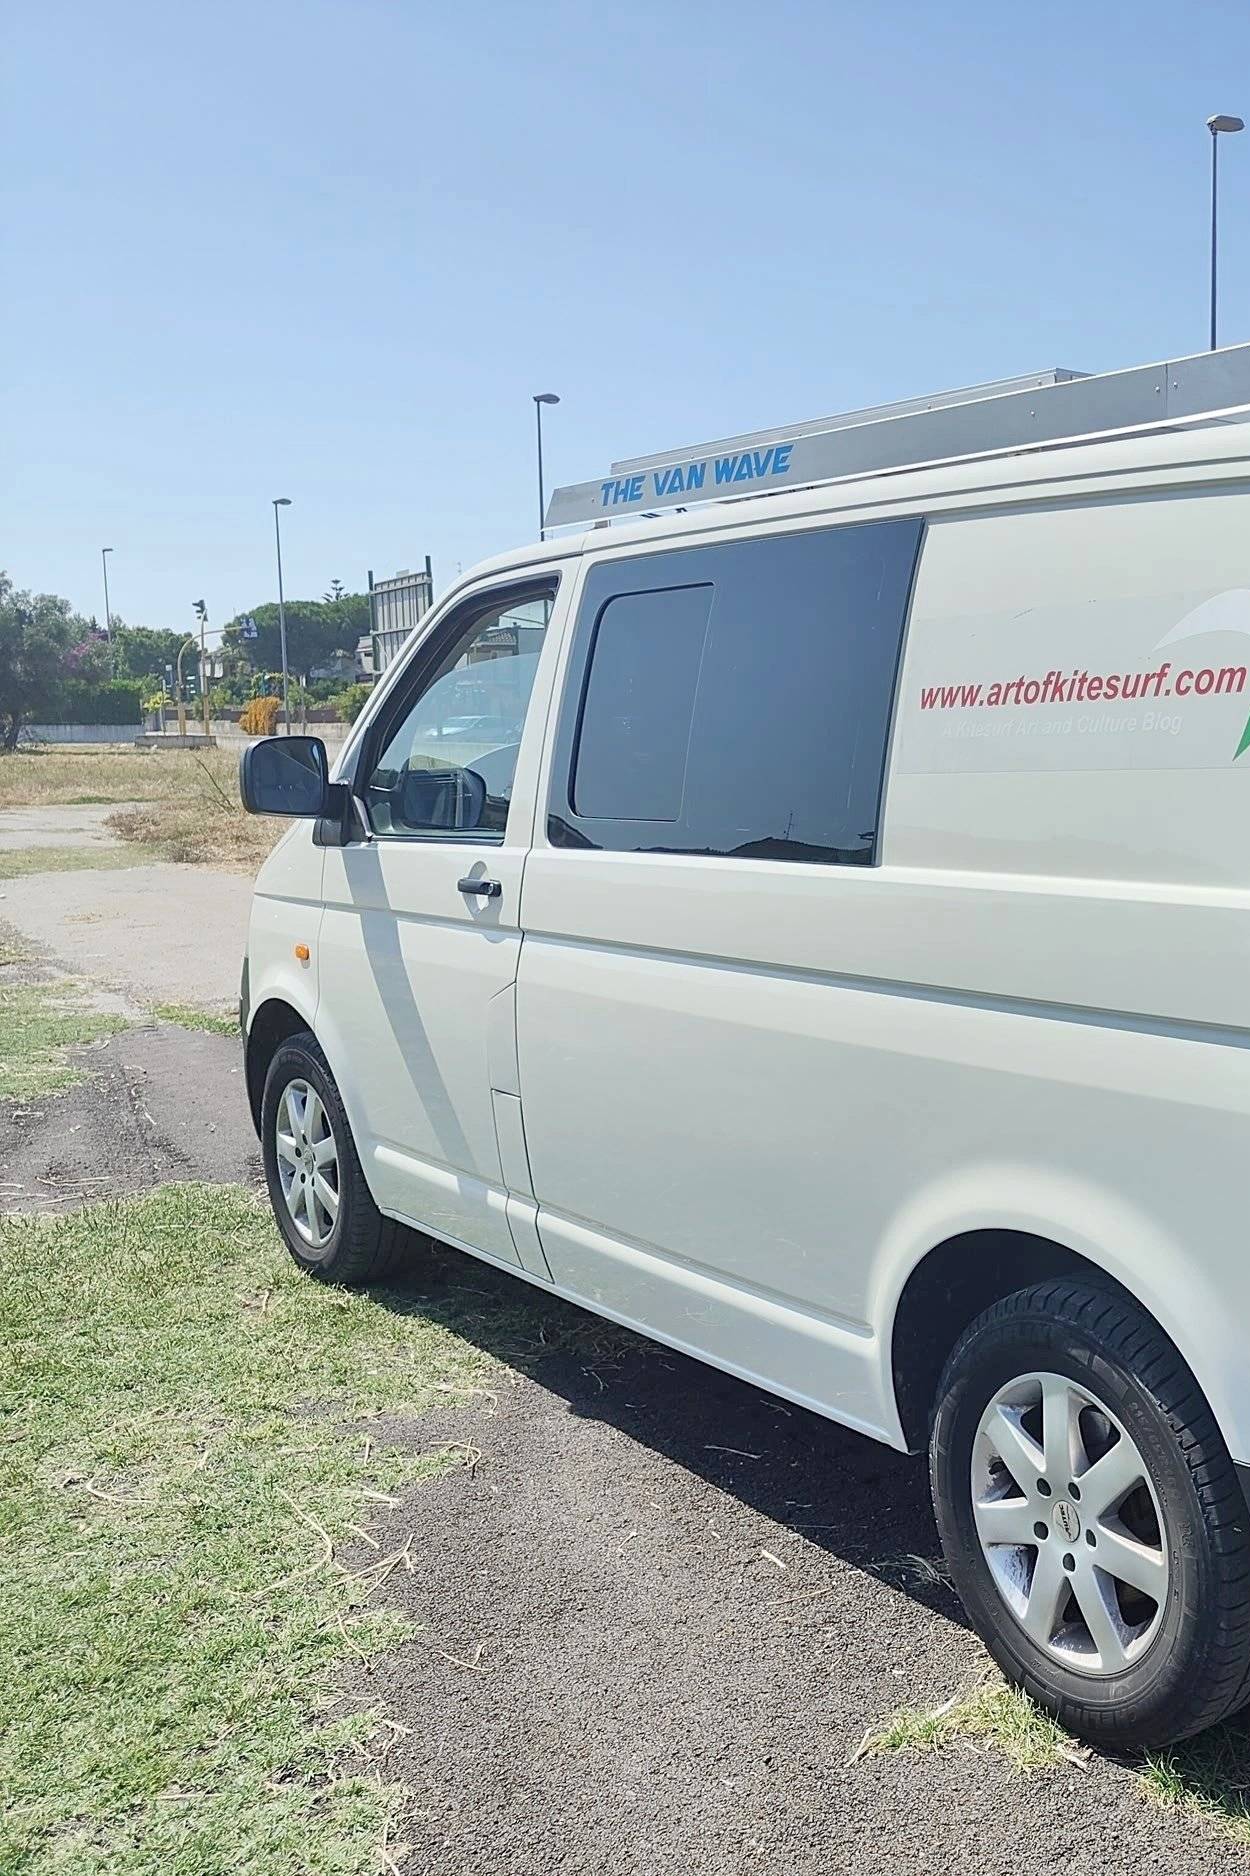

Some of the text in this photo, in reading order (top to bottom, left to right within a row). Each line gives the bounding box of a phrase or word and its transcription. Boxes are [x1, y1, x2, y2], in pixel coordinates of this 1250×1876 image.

[600, 444, 795, 507] THE VAN WAVE
[920, 663, 1247, 710] www.artofkitesurf.com
[1041, 716, 1073, 735] and
[1078, 711, 1137, 734] Culture
[1142, 710, 1183, 735] Blog
